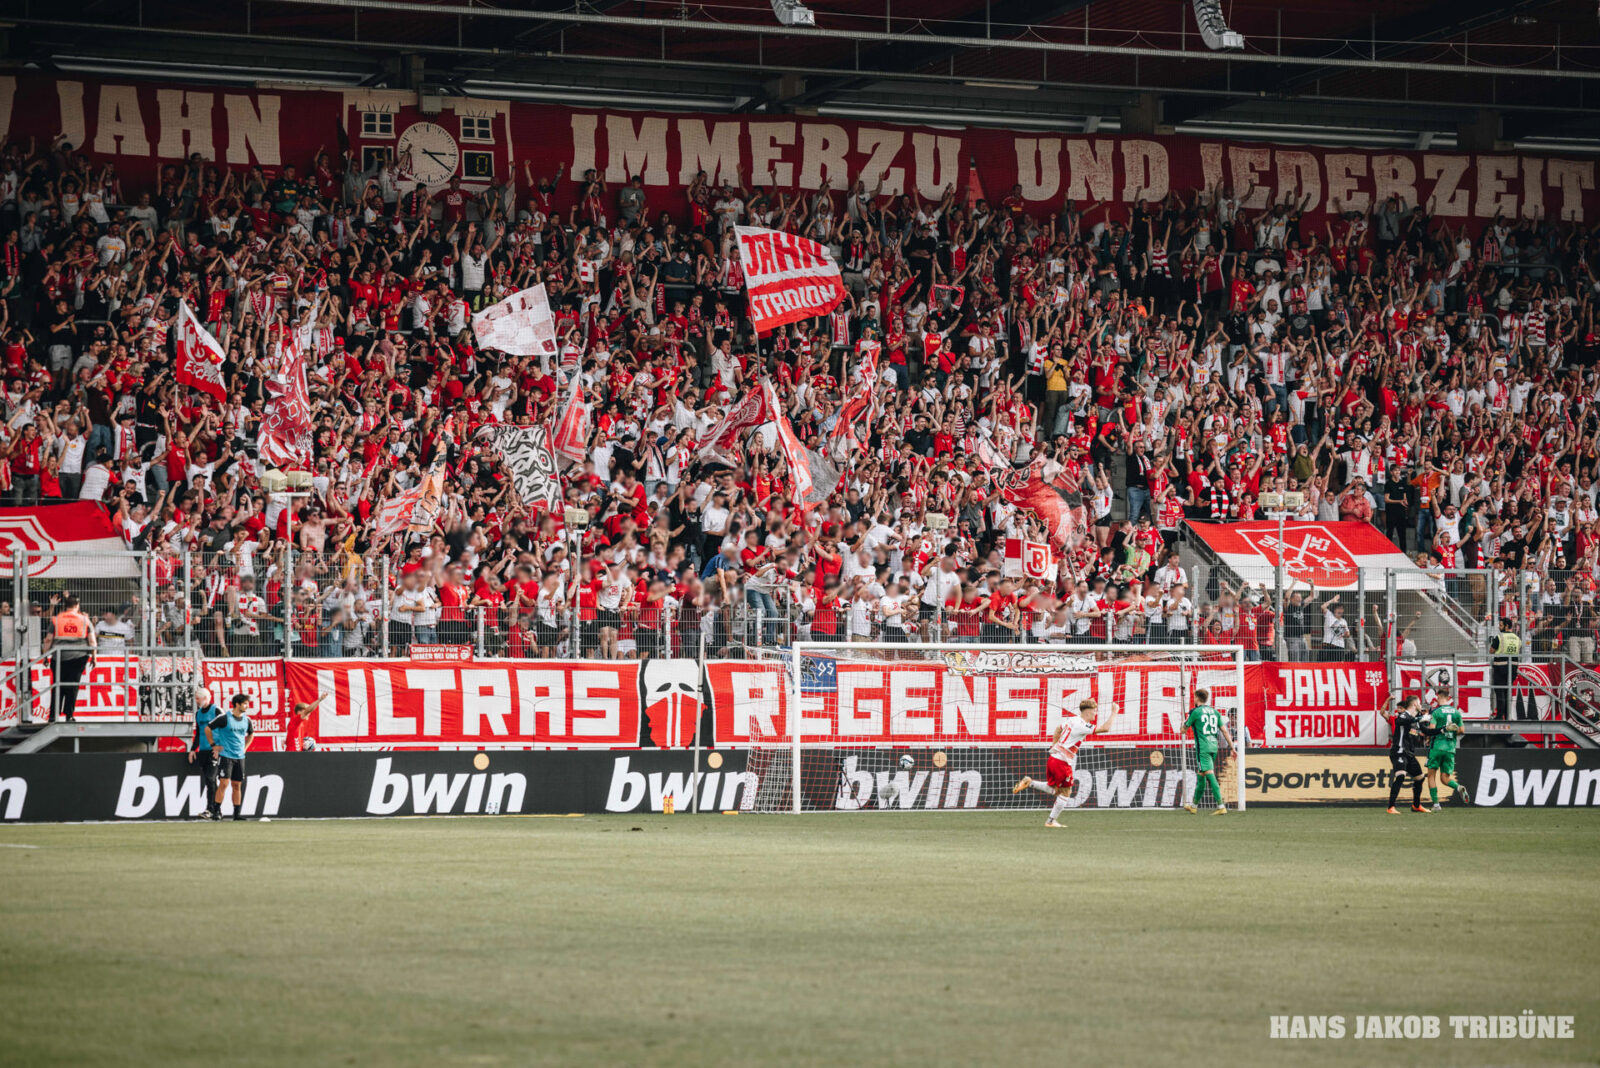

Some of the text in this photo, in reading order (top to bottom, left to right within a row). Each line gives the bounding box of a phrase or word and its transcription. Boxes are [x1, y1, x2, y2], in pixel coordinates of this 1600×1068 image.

[53, 80, 281, 165] JAHN
[571, 114, 961, 200] IMMERZU
[1015, 138, 1169, 202] UND
[1199, 143, 1596, 222] JEDERZEIT
[741, 232, 828, 277] JAHN
[751, 284, 837, 321] STADION
[206, 662, 277, 678] SSV JAHN
[818, 662, 834, 676] 95
[1275, 668, 1359, 707] JAHN
[208, 680, 279, 716] 1889
[316, 669, 620, 737] ULTRAS
[1201, 714, 1218, 735] 29
[1275, 714, 1360, 738] STADION
[366, 753, 527, 814] bwin
[605, 752, 758, 812] bwin
[835, 752, 982, 810] bwin
[1245, 767, 1428, 793] Sportwette
